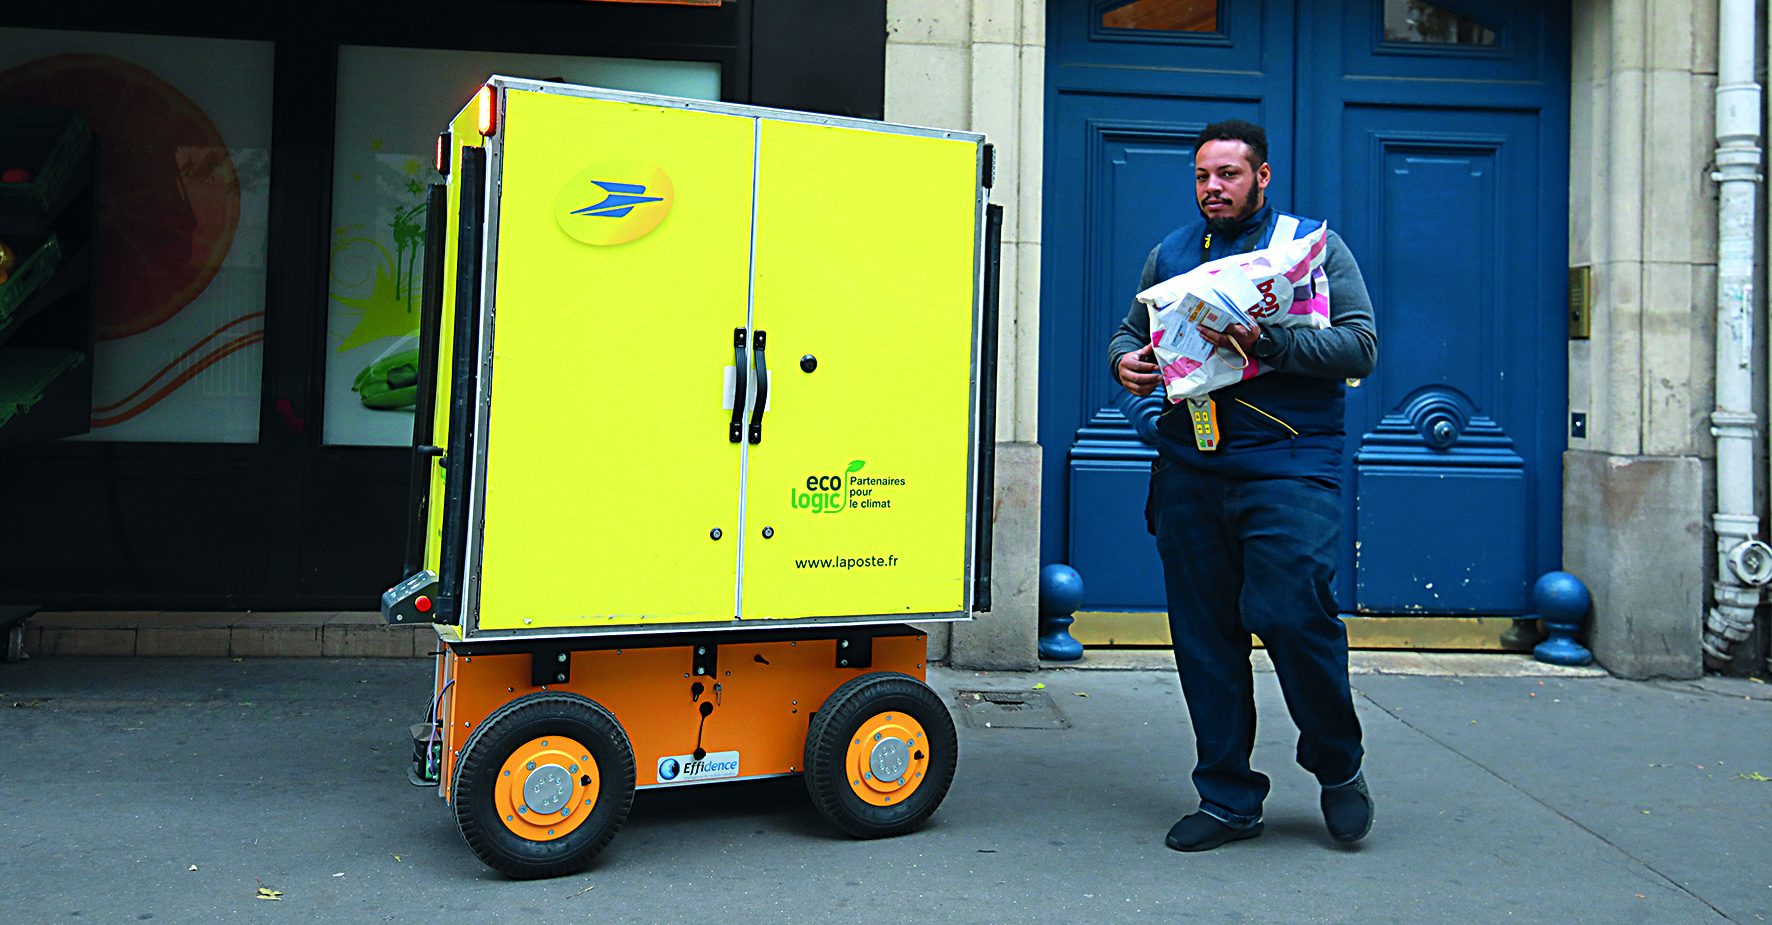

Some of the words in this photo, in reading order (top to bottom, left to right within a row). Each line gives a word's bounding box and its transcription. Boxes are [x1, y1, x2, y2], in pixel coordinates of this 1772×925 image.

[1256, 278, 1280, 318] bon
[806, 475, 842, 491] eco
[849, 476, 906, 486] Partenaires
[791, 487, 841, 514] logic
[849, 488, 873, 498] pour
[849, 499, 858, 508] le
[860, 499, 891, 509] climat
[795, 554, 899, 570] www.laposte.fr
[683, 760, 738, 776] Effidence
